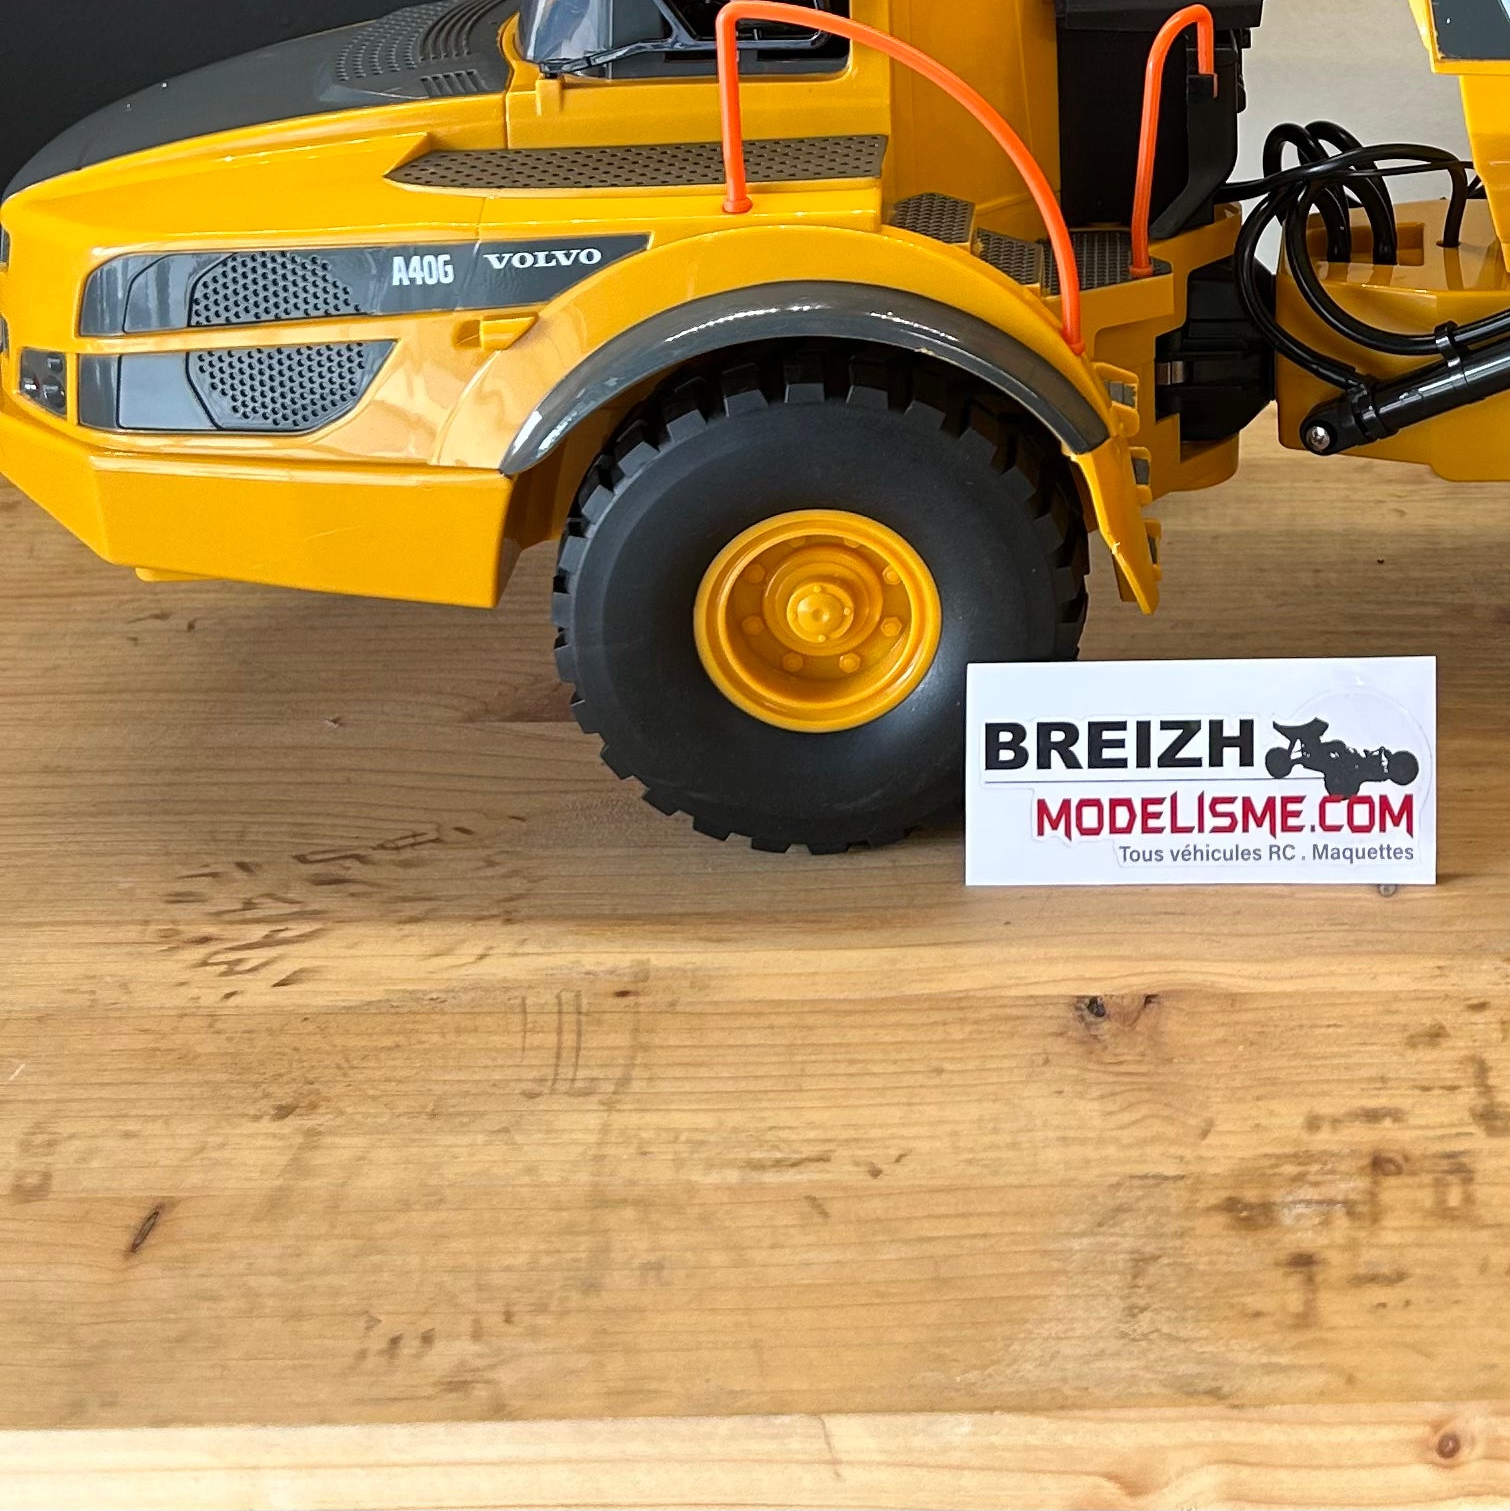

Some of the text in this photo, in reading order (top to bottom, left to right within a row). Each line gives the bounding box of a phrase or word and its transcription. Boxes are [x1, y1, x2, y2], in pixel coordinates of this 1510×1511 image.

[392, 248, 602, 286] A40G VOLVO
[984, 718, 1255, 771] BREIZH
[1036, 791, 1414, 841] MODELISME.COM
[1119, 844, 1164, 863] Tous
[1169, 843, 1262, 863] véhicules
[1268, 844, 1297, 861] RC
[1312, 843, 1414, 864] Maquettes
